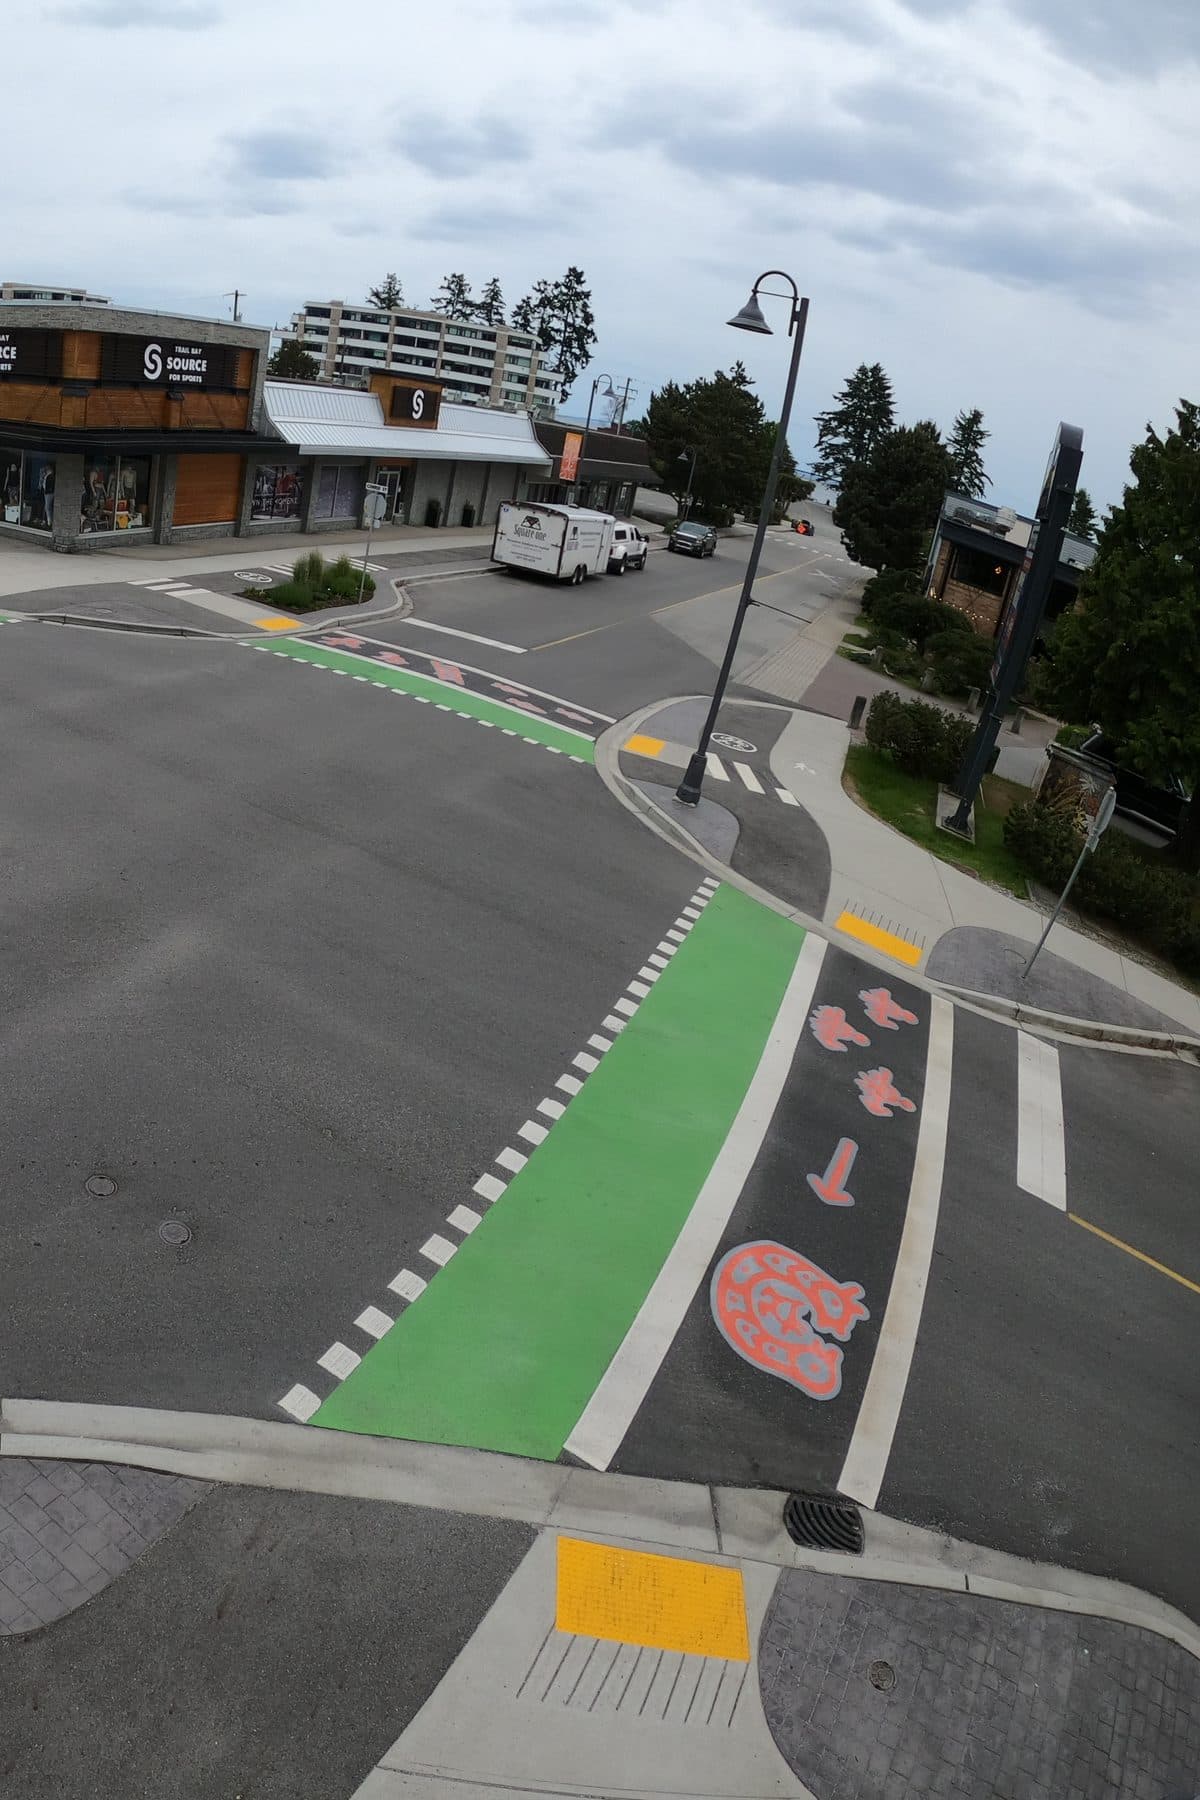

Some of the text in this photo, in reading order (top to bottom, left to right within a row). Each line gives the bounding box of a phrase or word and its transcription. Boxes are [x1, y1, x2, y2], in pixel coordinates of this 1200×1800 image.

[175, 346, 190, 354] TRAIL
[166, 356, 208, 372] SOURCE
[169, 374, 202, 383] FOR SPORTS
[514, 523, 535, 539] Square
